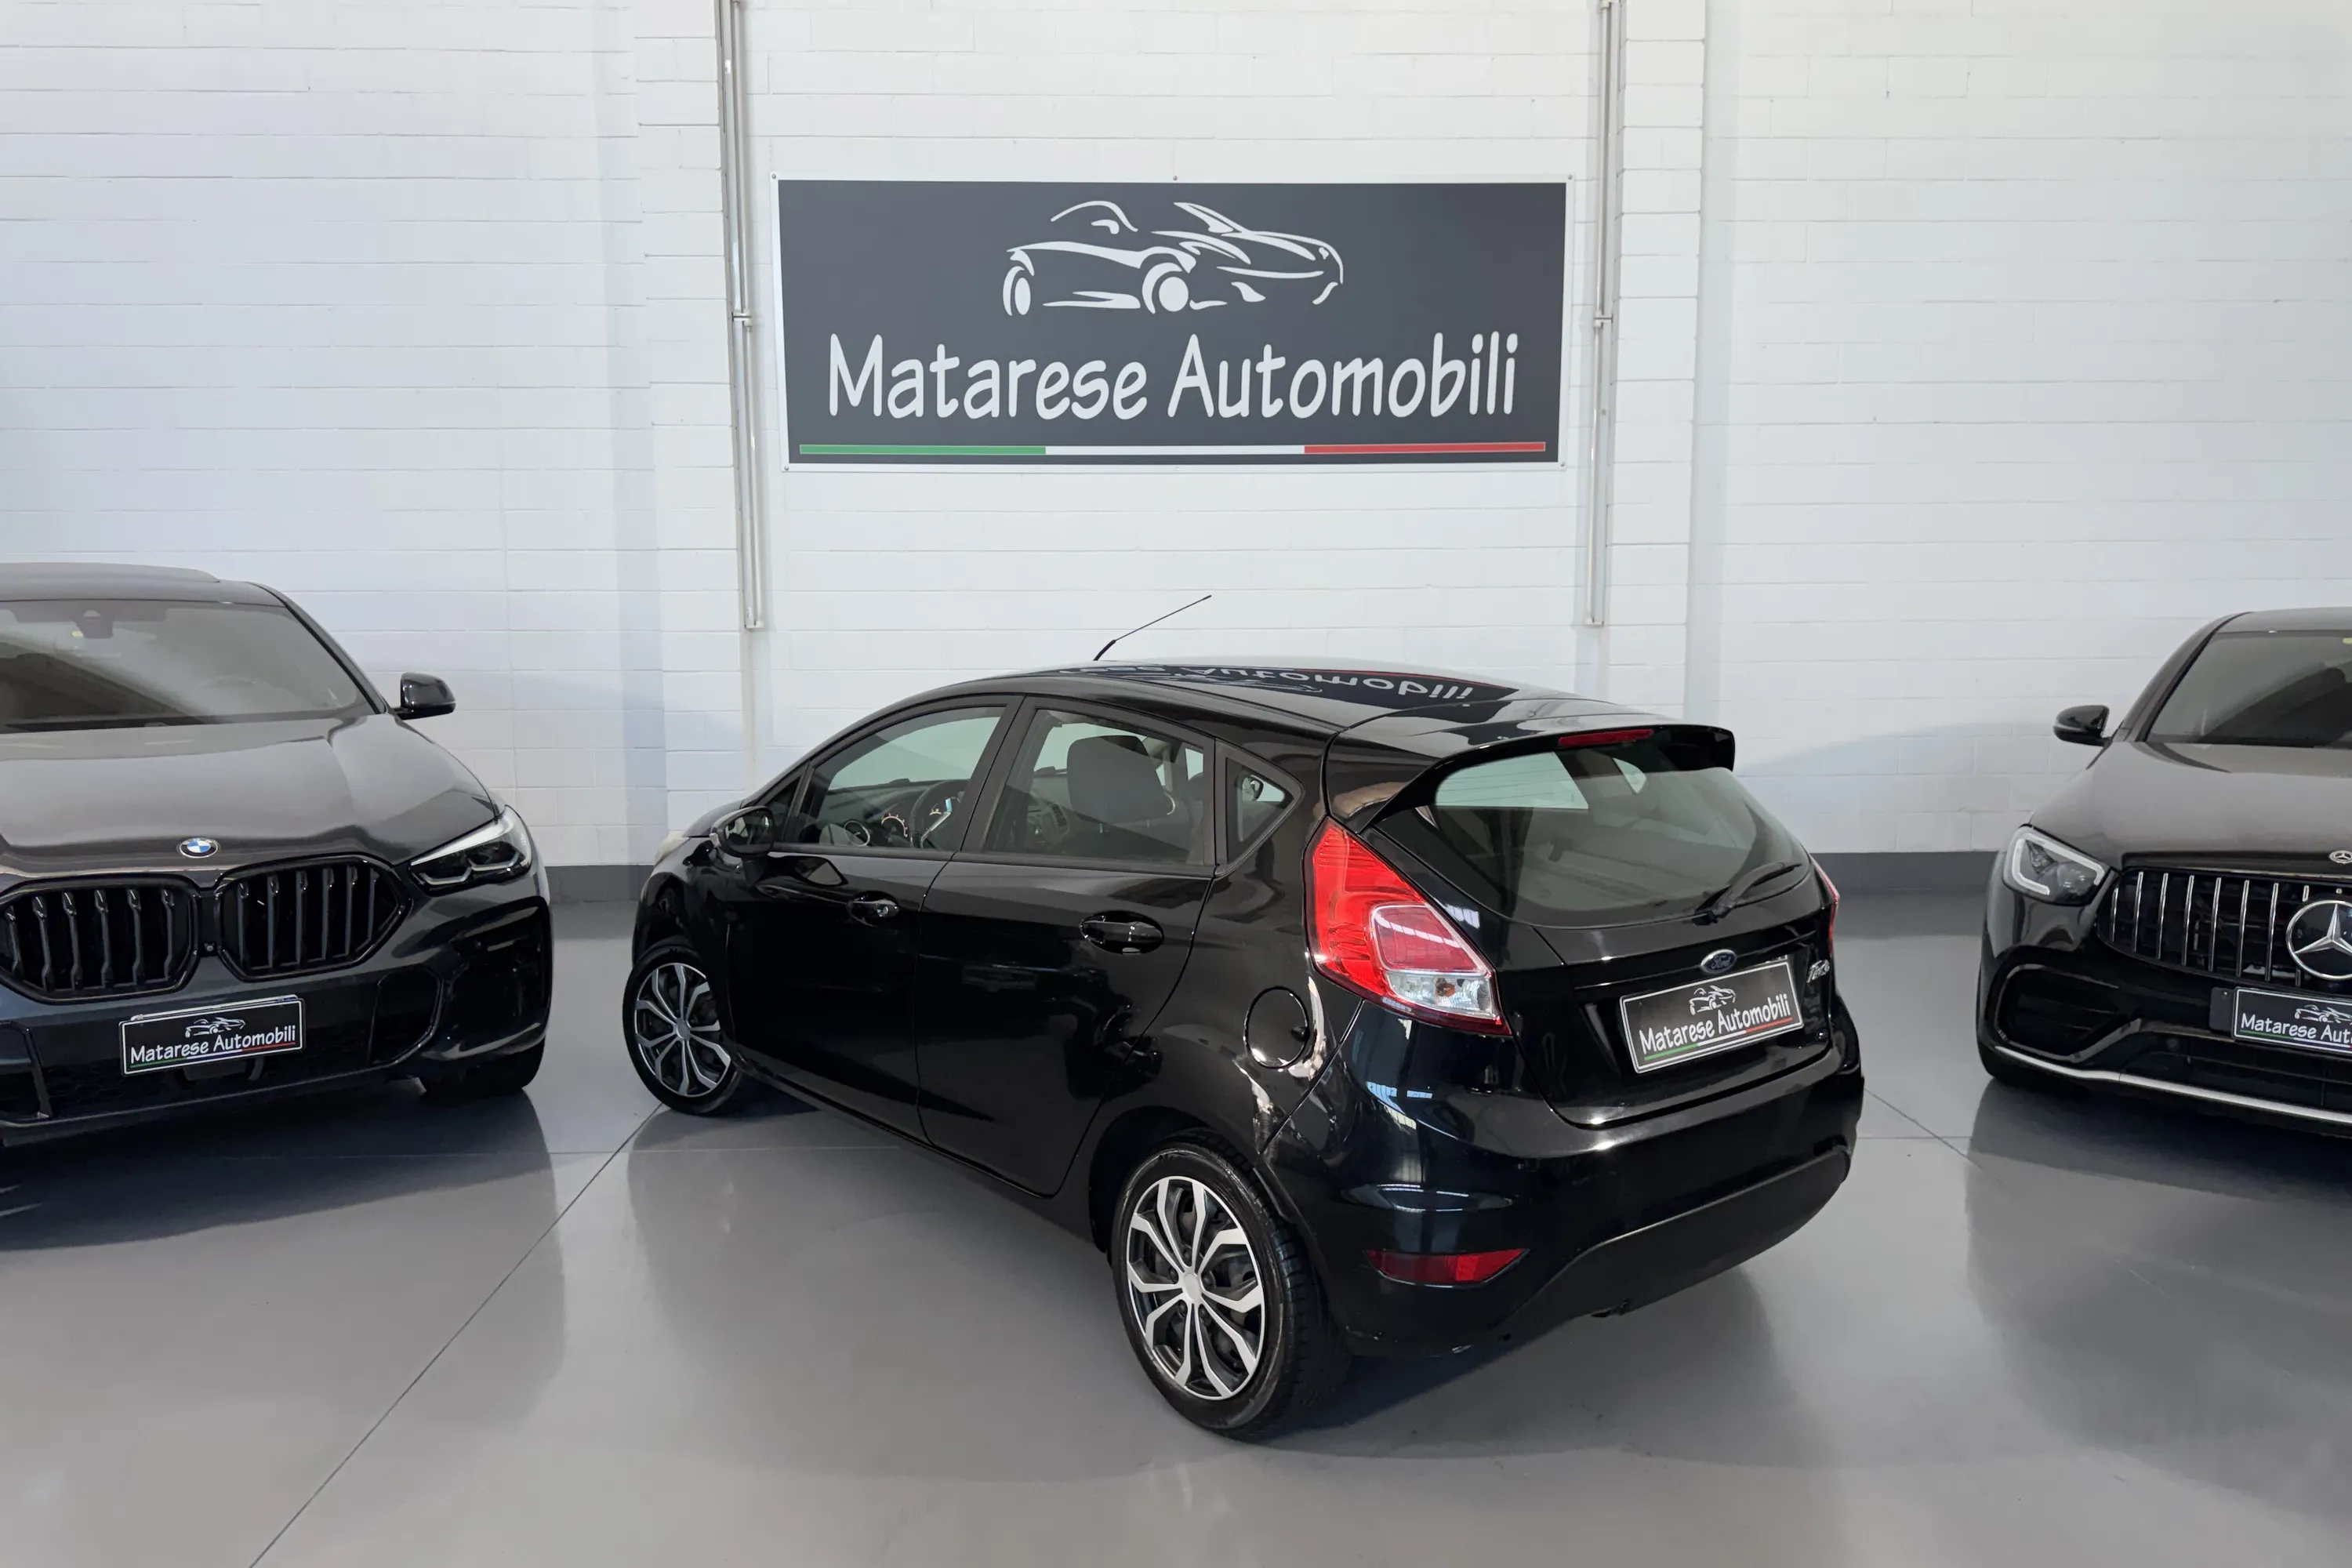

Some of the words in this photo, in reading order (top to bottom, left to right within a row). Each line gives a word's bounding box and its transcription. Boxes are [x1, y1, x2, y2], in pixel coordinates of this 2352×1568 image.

[829, 333, 1148, 420] Matarese
[1167, 330, 1519, 419] Automobili
[1711, 954, 1731, 969] Ford
[1639, 1018, 1715, 1054] Matarese
[1717, 993, 1791, 1034] Automobili
[2241, 1012, 2318, 1039] Matarese
[2321, 1024, 2352, 1044] Aut
[130, 1041, 209, 1064] Matarese
[213, 1025, 296, 1052] Automobili
